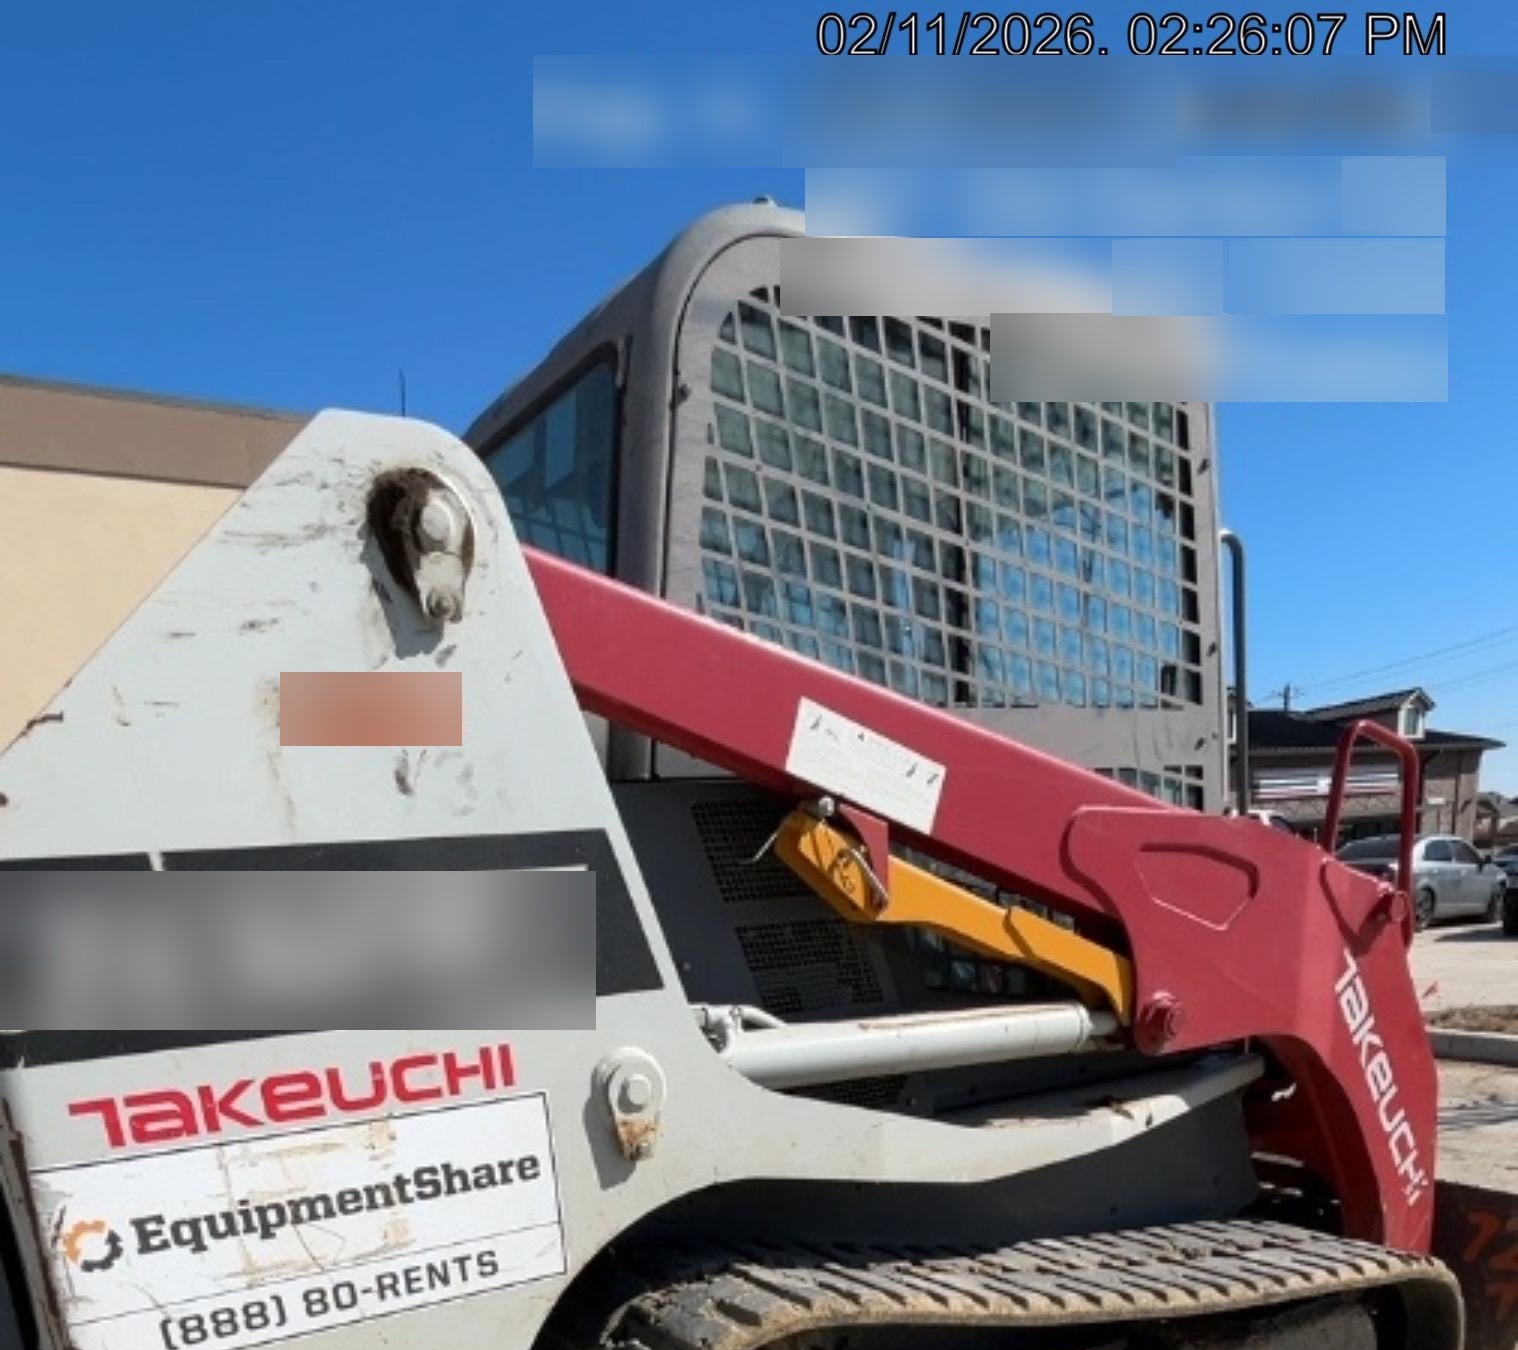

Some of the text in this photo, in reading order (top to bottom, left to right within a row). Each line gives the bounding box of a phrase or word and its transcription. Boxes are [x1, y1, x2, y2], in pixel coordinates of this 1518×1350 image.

[68, 1043, 516, 1148] TAKEUCHI
[1334, 947, 1430, 1207] TAKEUCHI
[131, 1153, 541, 1256] EquipmentShare
[303, 1250, 499, 1318] 80-RENTS
